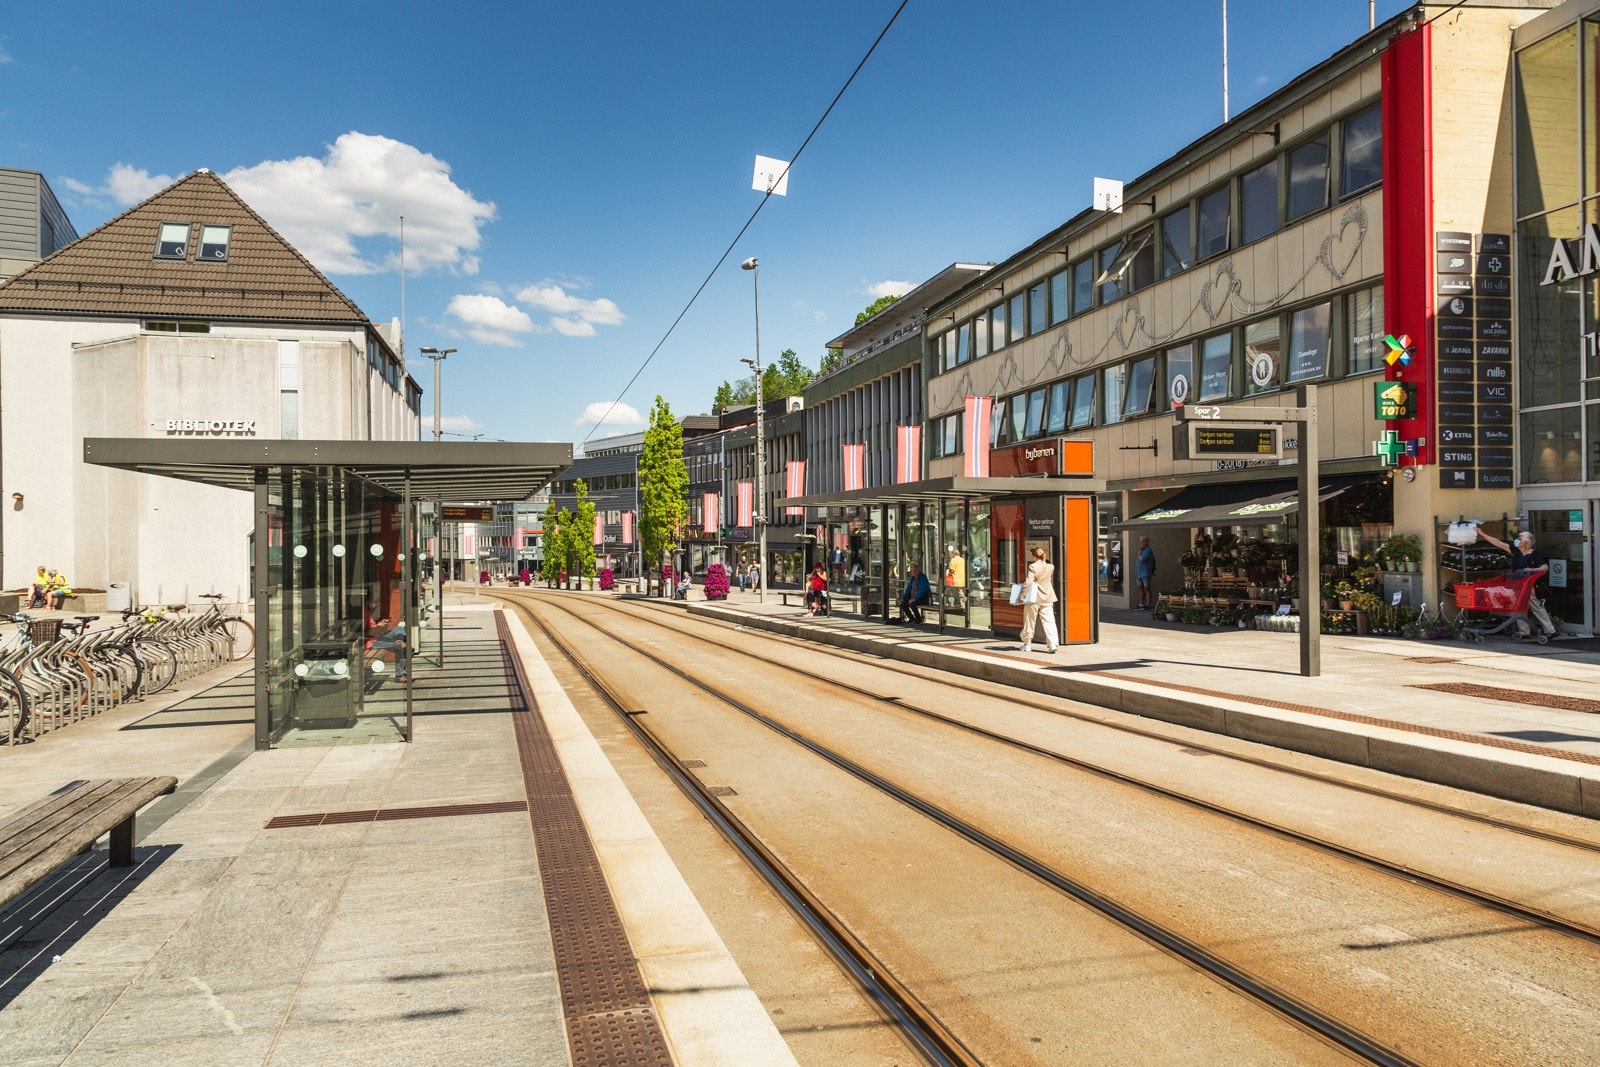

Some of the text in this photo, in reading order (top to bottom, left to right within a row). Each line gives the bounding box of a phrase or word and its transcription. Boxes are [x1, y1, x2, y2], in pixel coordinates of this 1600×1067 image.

[1486, 367, 1506, 377] nille
[1486, 387, 1506, 396] VIC
[1194, 406, 1221, 419] Spor 2
[1381, 406, 1406, 416] TOTO
[165, 419, 256, 433] BIBLIOTEK
[1025, 447, 1055, 460] bybanen
[1444, 453, 1472, 461] STING
